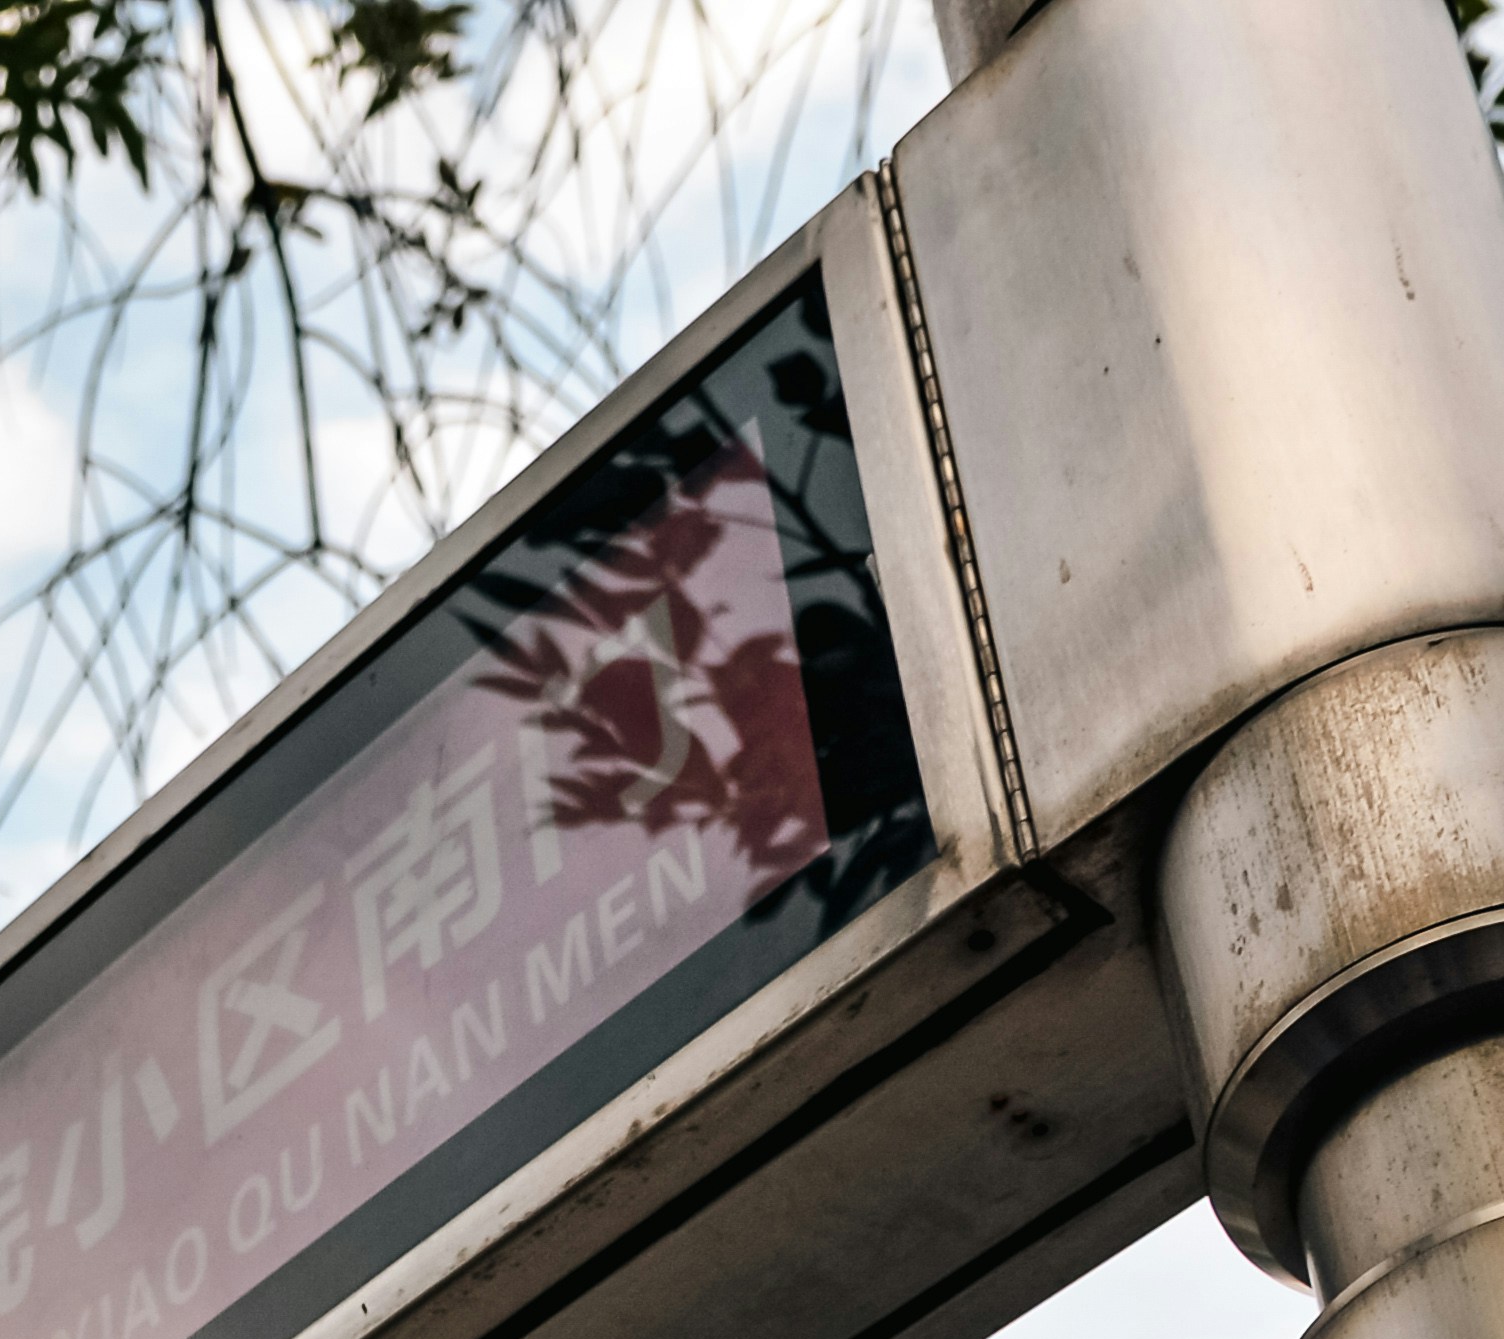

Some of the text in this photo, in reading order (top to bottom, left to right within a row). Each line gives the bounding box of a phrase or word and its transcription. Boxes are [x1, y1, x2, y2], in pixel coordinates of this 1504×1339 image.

[227, 1123, 326, 1255] QU
[344, 980, 508, 1167] NAN
[525, 829, 708, 1027] MEN
